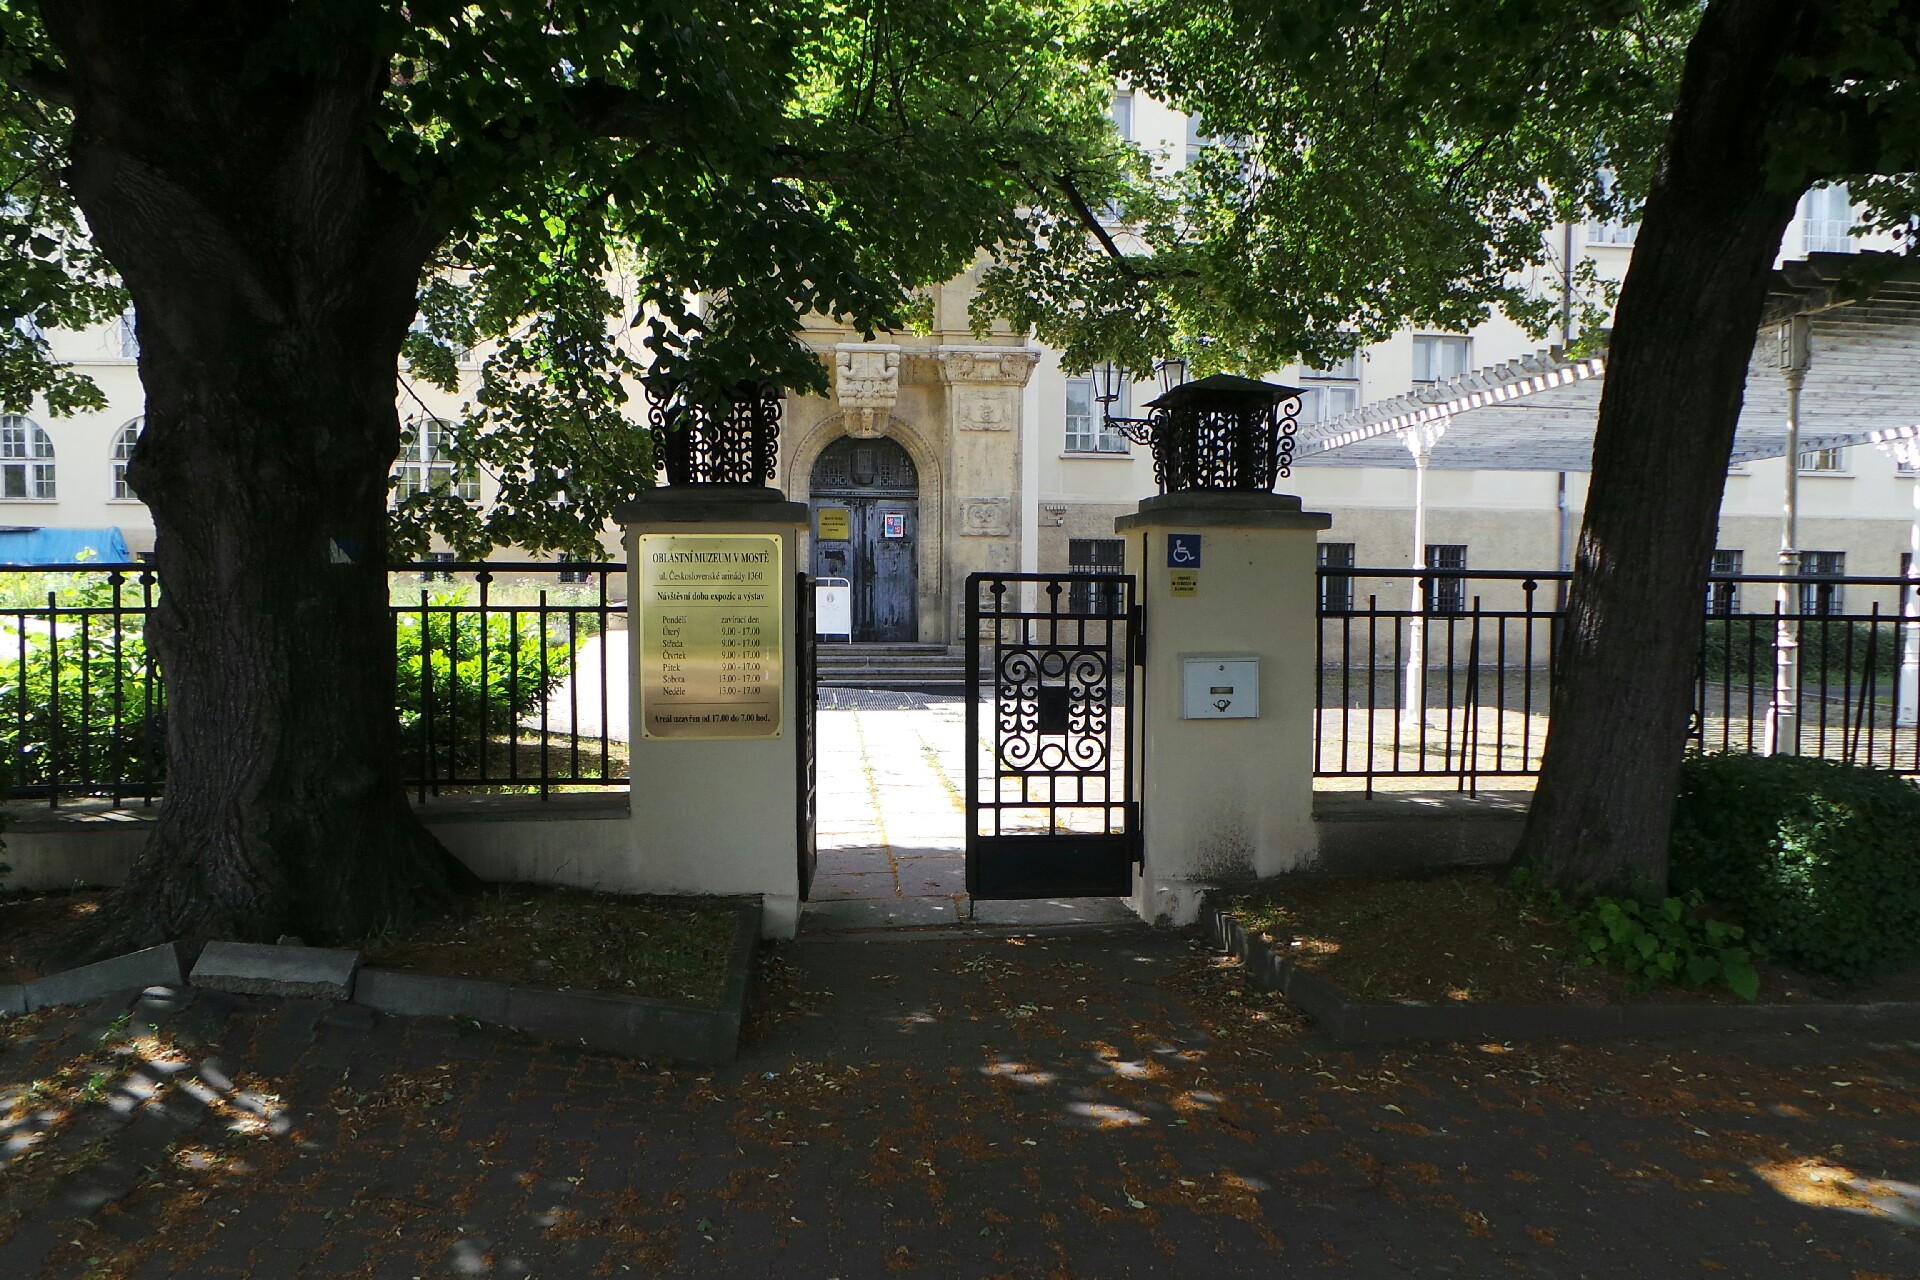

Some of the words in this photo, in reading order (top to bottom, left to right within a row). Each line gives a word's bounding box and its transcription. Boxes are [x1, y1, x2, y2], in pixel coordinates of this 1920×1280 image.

[652, 550, 694, 563] OBLASTNÍ
[695, 553, 731, 563] MUZEUM
[733, 553, 740, 563] V
[741, 550, 769, 563] MOSTĚ
[659, 572, 668, 580] ul.
[669, 570, 720, 580] Československé
[722, 572, 745, 582] armády
[748, 572, 762, 580] 1360
[657, 592, 690, 601] Návštěvní
[692, 592, 709, 600] doba
[710, 592, 735, 602] expozic
[744, 592, 764, 602] výstav
[662, 626, 680, 637] Úterý
[742, 627, 760, 635] 17.00
[662, 639, 683, 648] Středa
[662, 650, 686, 660] Čtvrtek
[662, 663, 680, 671] Pátek
[662, 675, 685, 683] Sobota
[662, 687, 685, 695] Neděle
[743, 687, 760, 695] 17.00
[674, 714, 700, 723] uzavřen
